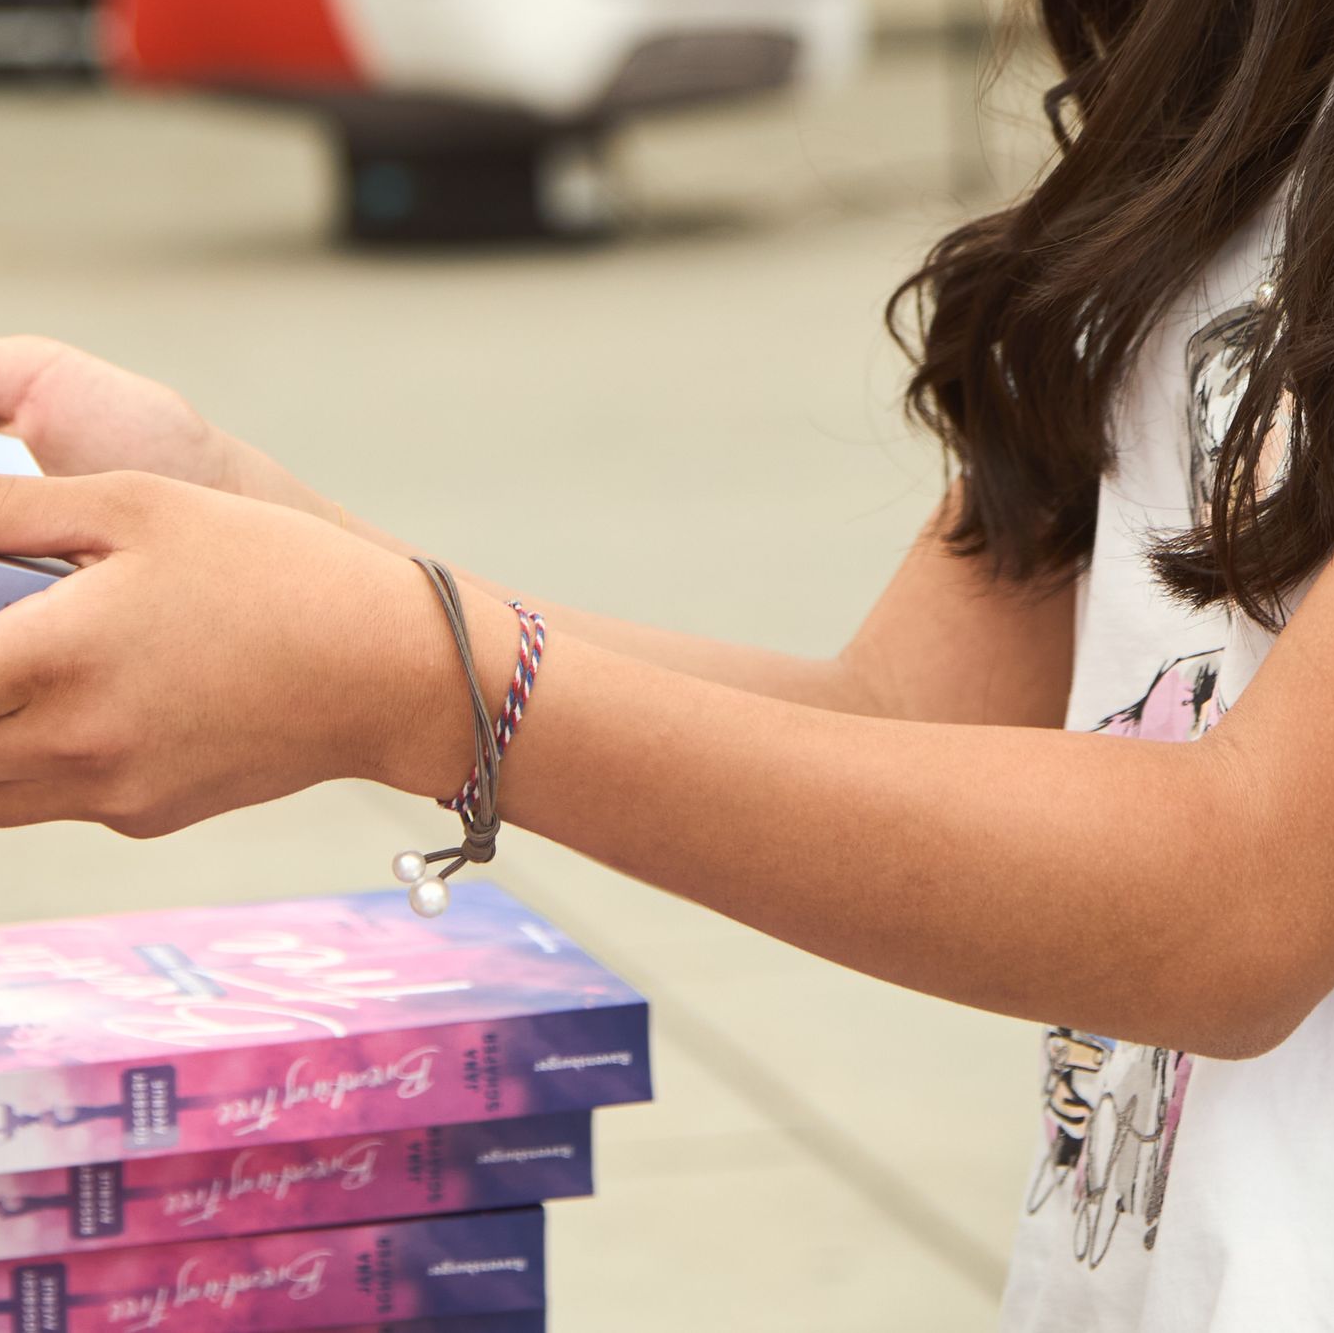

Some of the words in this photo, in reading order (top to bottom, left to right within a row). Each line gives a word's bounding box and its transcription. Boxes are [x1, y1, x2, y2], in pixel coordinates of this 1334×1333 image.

[283, 1044, 441, 1110] Breaking
[215, 1086, 280, 1137] Free
[229, 1141, 386, 1200] Breaking
[163, 1178, 225, 1228] Free
[173, 1247, 333, 1309] Breaking
[107, 1289, 168, 1333] Free
